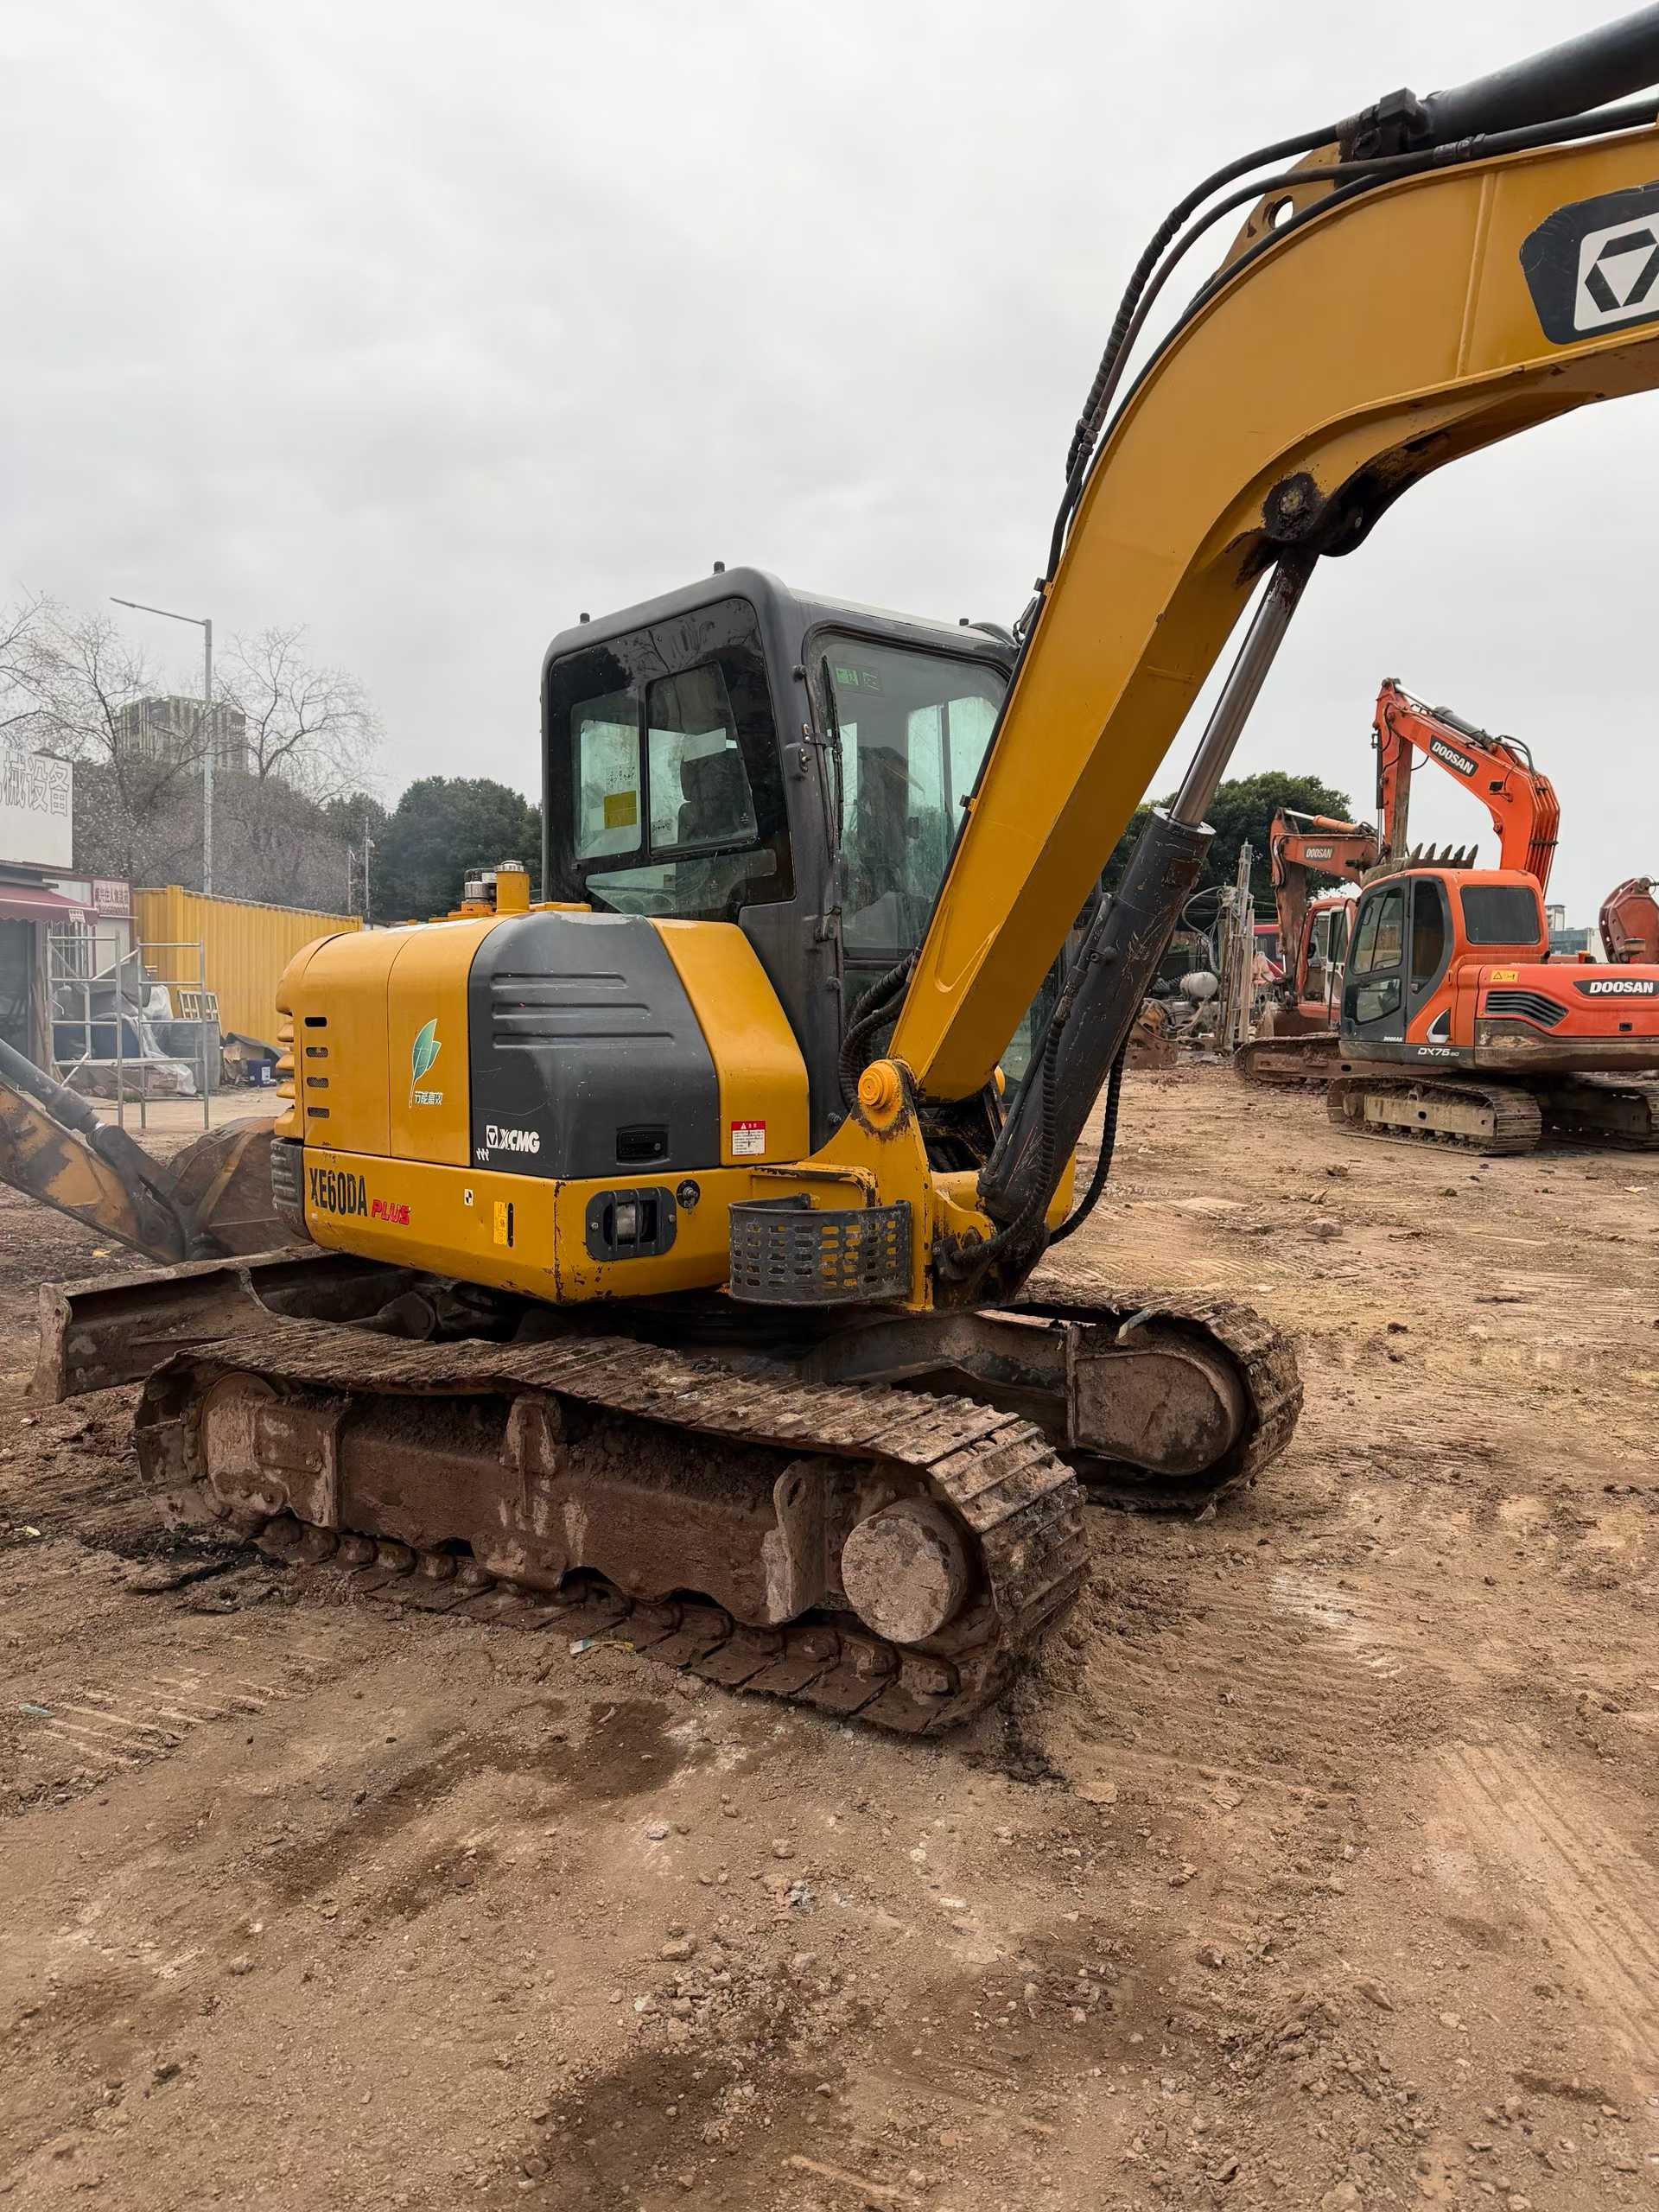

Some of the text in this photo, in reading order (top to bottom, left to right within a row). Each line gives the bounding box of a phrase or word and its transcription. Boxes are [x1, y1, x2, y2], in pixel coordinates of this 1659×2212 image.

[1432, 741, 1474, 774] DOOSAN
[0, 751, 70, 817] 械设备
[1306, 848, 1333, 859] DOOSAN
[1589, 981, 1654, 994] DOOSAN
[414, 1090, 443, 1106] 节能高效
[498, 1128, 541, 1154] XCMG
[309, 1167, 411, 1226] XE60DA PLUS
